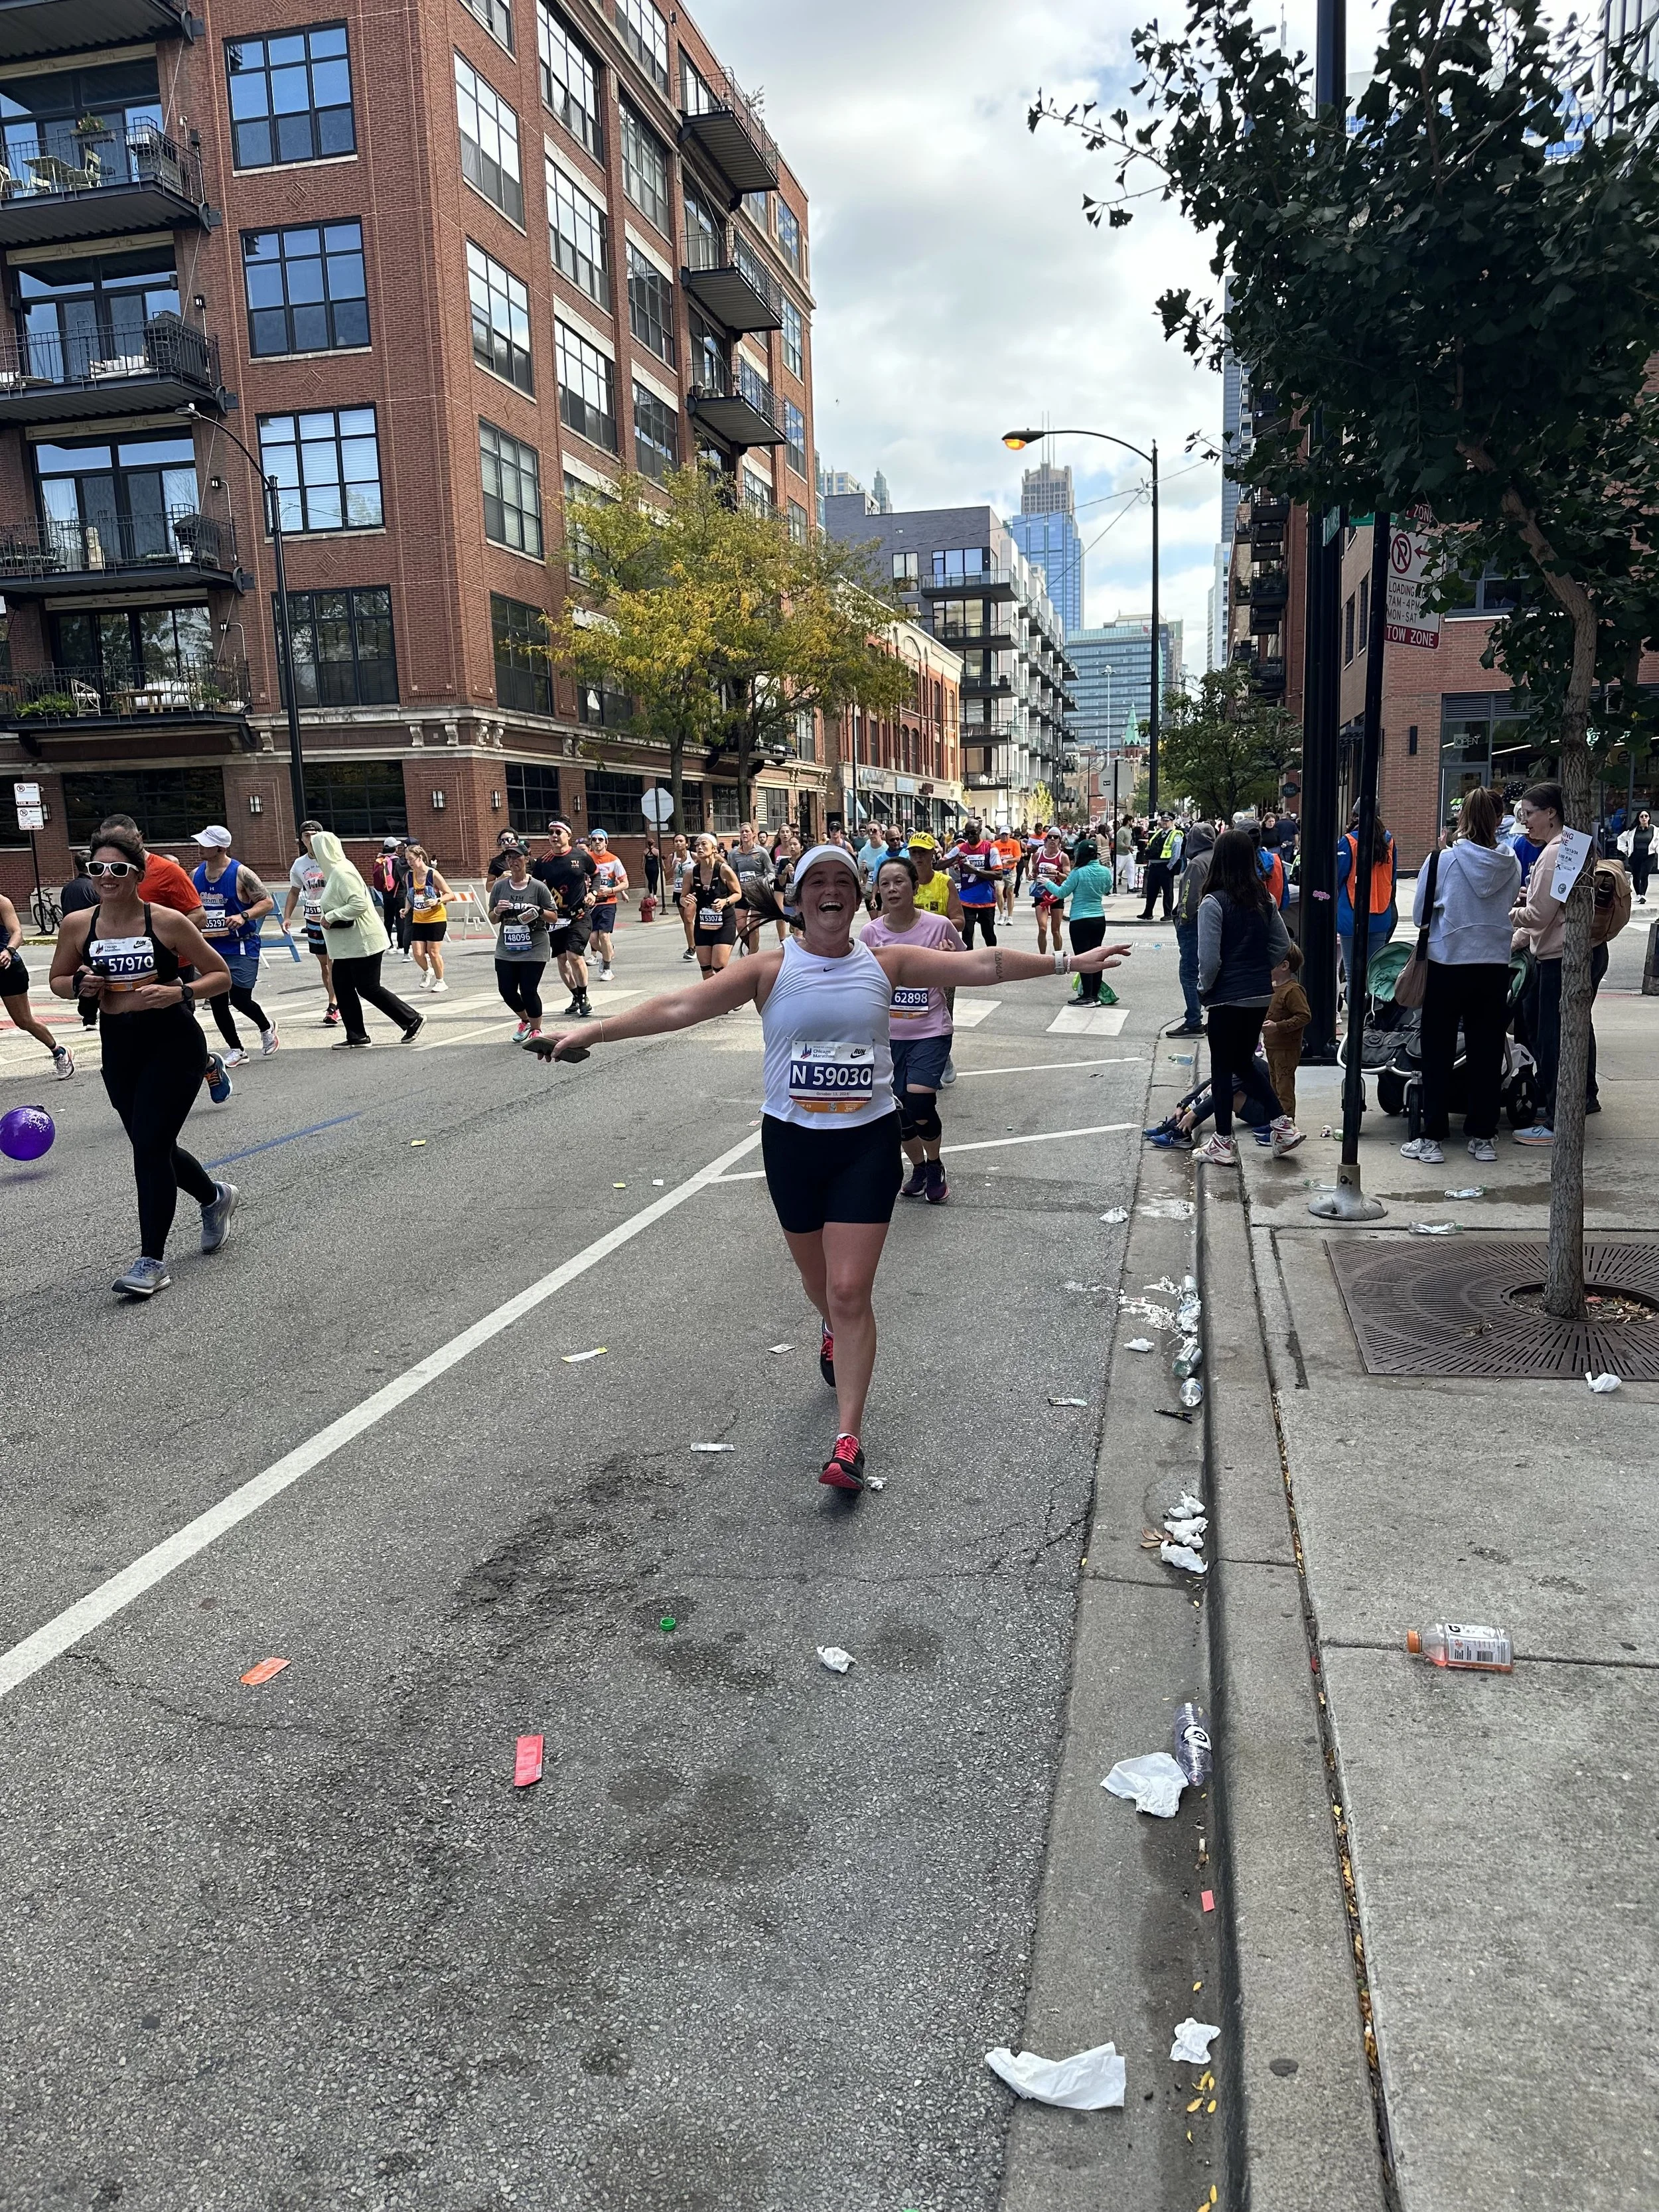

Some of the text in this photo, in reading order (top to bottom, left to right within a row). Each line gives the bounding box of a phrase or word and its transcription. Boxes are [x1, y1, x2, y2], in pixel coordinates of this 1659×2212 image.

[1389, 581, 1415, 597] LOADING
[1387, 625, 1435, 647] TOW ZONE
[508, 932, 531, 942] 48096
[108, 955, 154, 972] 57970
[895, 992, 928, 1003] 62898
[792, 1065, 872, 1086] N 59030
